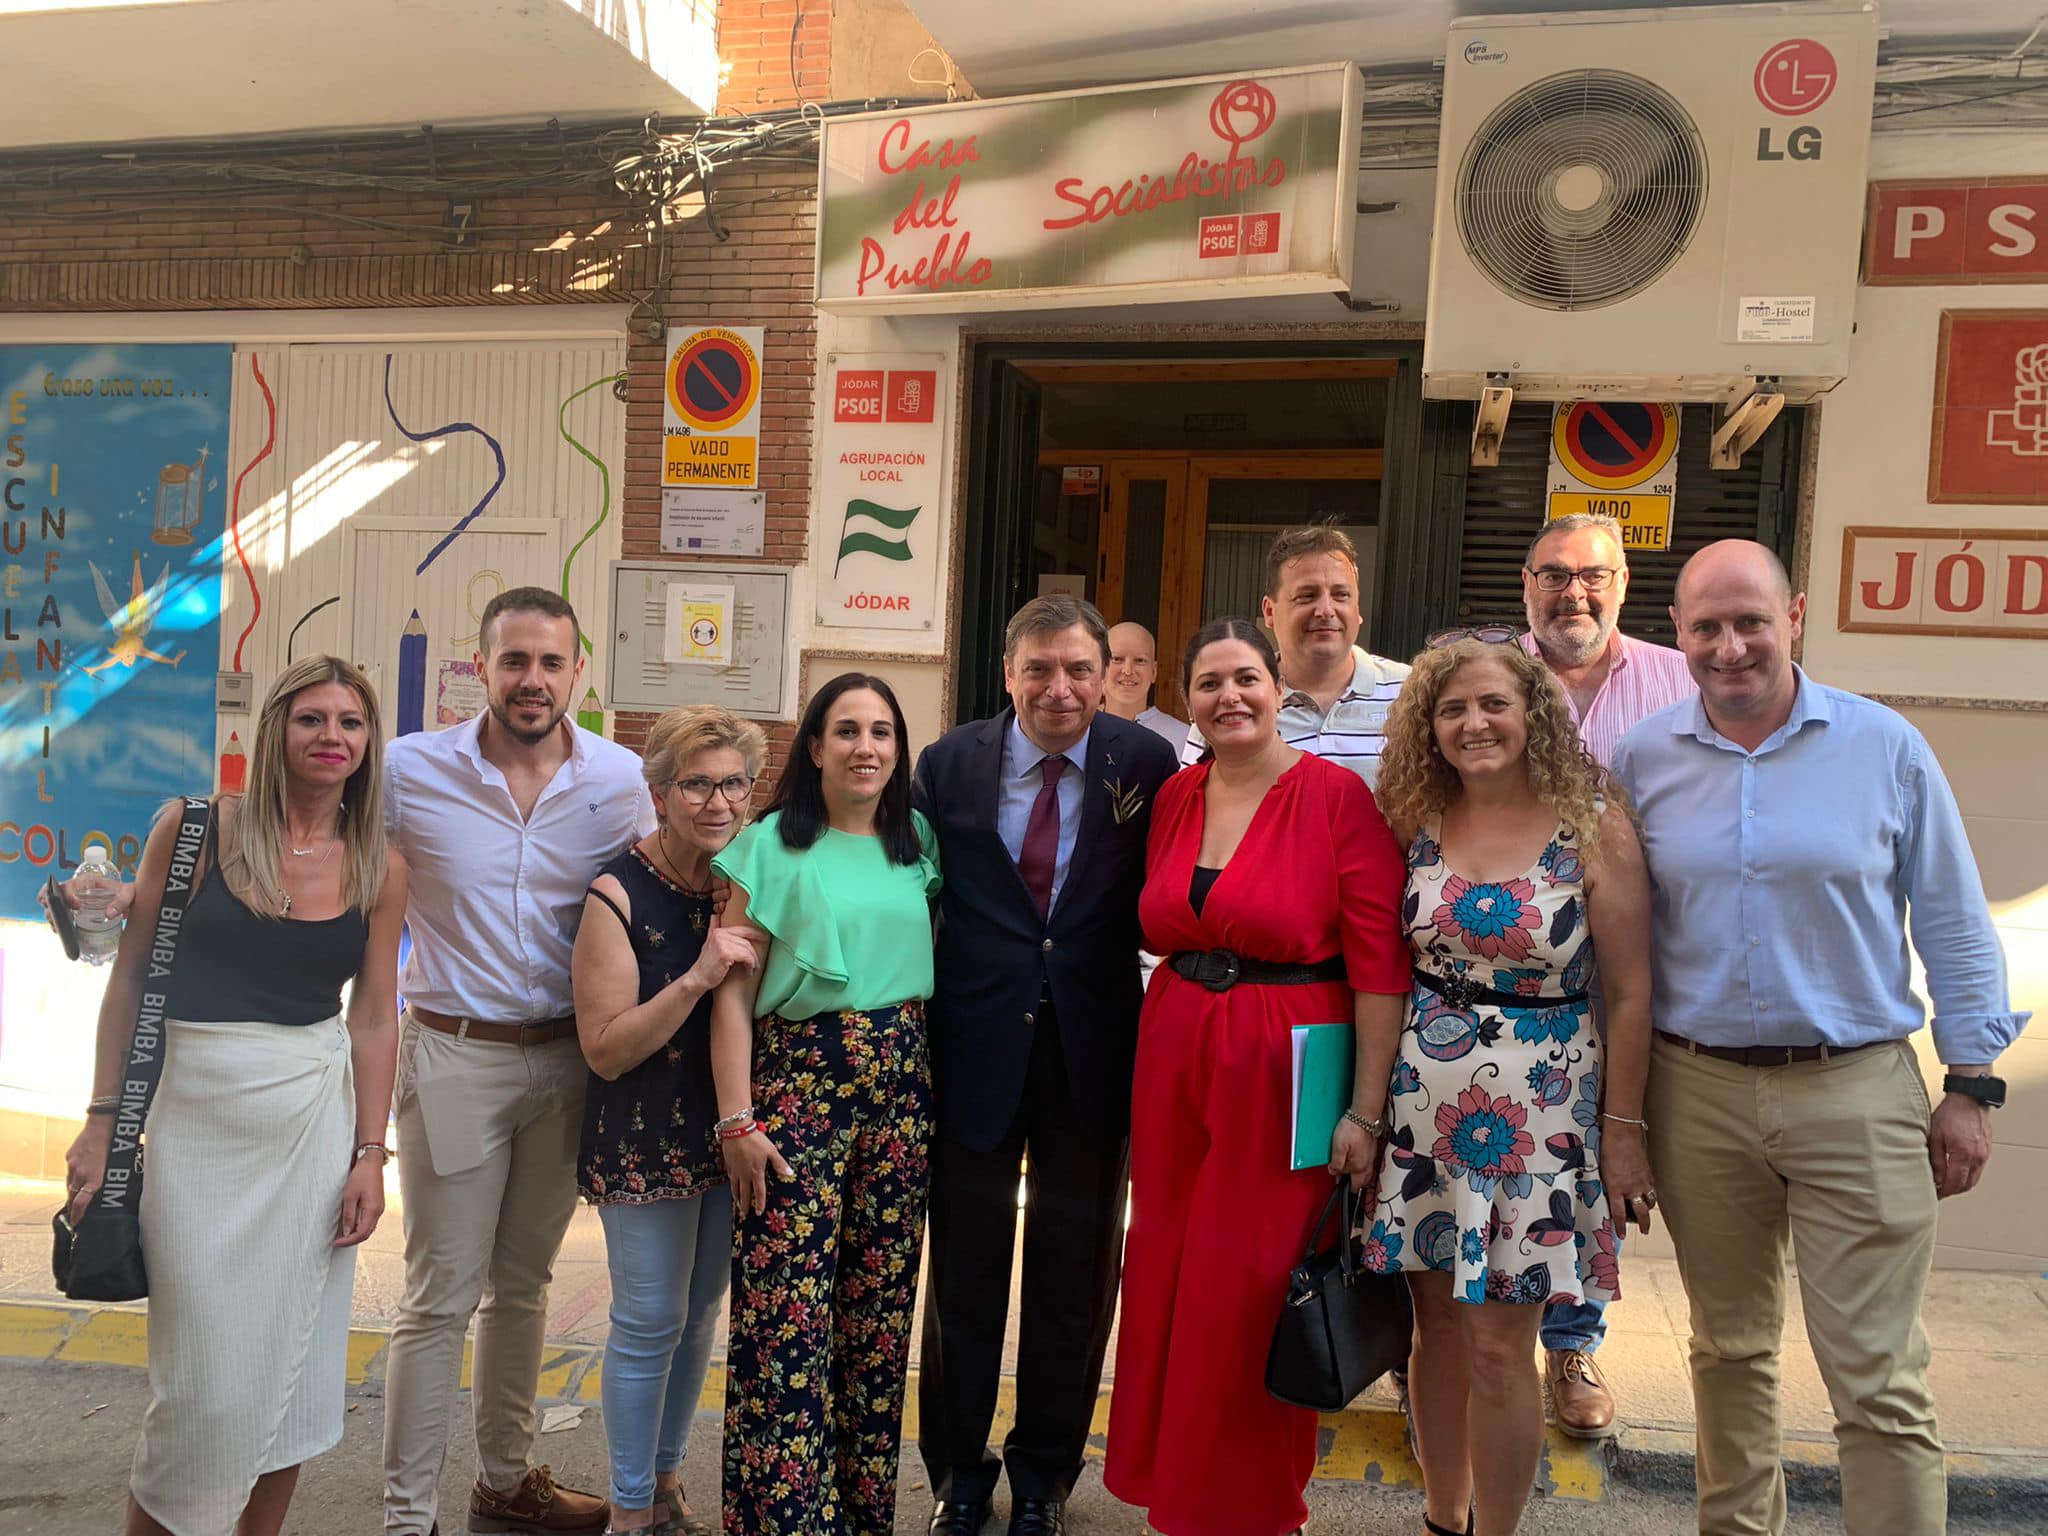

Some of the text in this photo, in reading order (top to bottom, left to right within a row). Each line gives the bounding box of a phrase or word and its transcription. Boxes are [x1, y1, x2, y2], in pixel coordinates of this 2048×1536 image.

[879, 119, 981, 175] Casa
[1757, 126, 1822, 160] LG
[893, 174, 961, 235] del
[1043, 147, 1286, 230] Socialistas
[453, 205, 472, 244] 7
[1206, 223, 1233, 234] JÓDAR
[1203, 235, 1236, 251] PSOE
[857, 231, 992, 296] Pueblo
[673, 337, 697, 362] SALIDA
[701, 330, 712, 338] DE
[100, 379, 136, 397] una
[842, 379, 879, 389] JÓDAR
[838, 398, 880, 415] PSOE
[690, 440, 729, 456] VADO
[839, 451, 925, 465] AGRUPACIÓN
[668, 462, 751, 479] PERMANENTE
[860, 470, 904, 481] LOCAL
[1653, 484, 1672, 494] 1244
[1587, 500, 1631, 519] VADO
[1, 391, 28, 685] ESCUELA
[1860, 541, 2048, 615] JÓD
[844, 592, 910, 610] JÓDAR
[36, 463, 66, 802] INFANTIL
[0, 820, 148, 875] COLOR
[166, 822, 204, 891] BIMBA
[149, 906, 182, 978] BIMBA
[130, 992, 166, 1065] BIMBA
[112, 1079, 149, 1152] BIMBA
